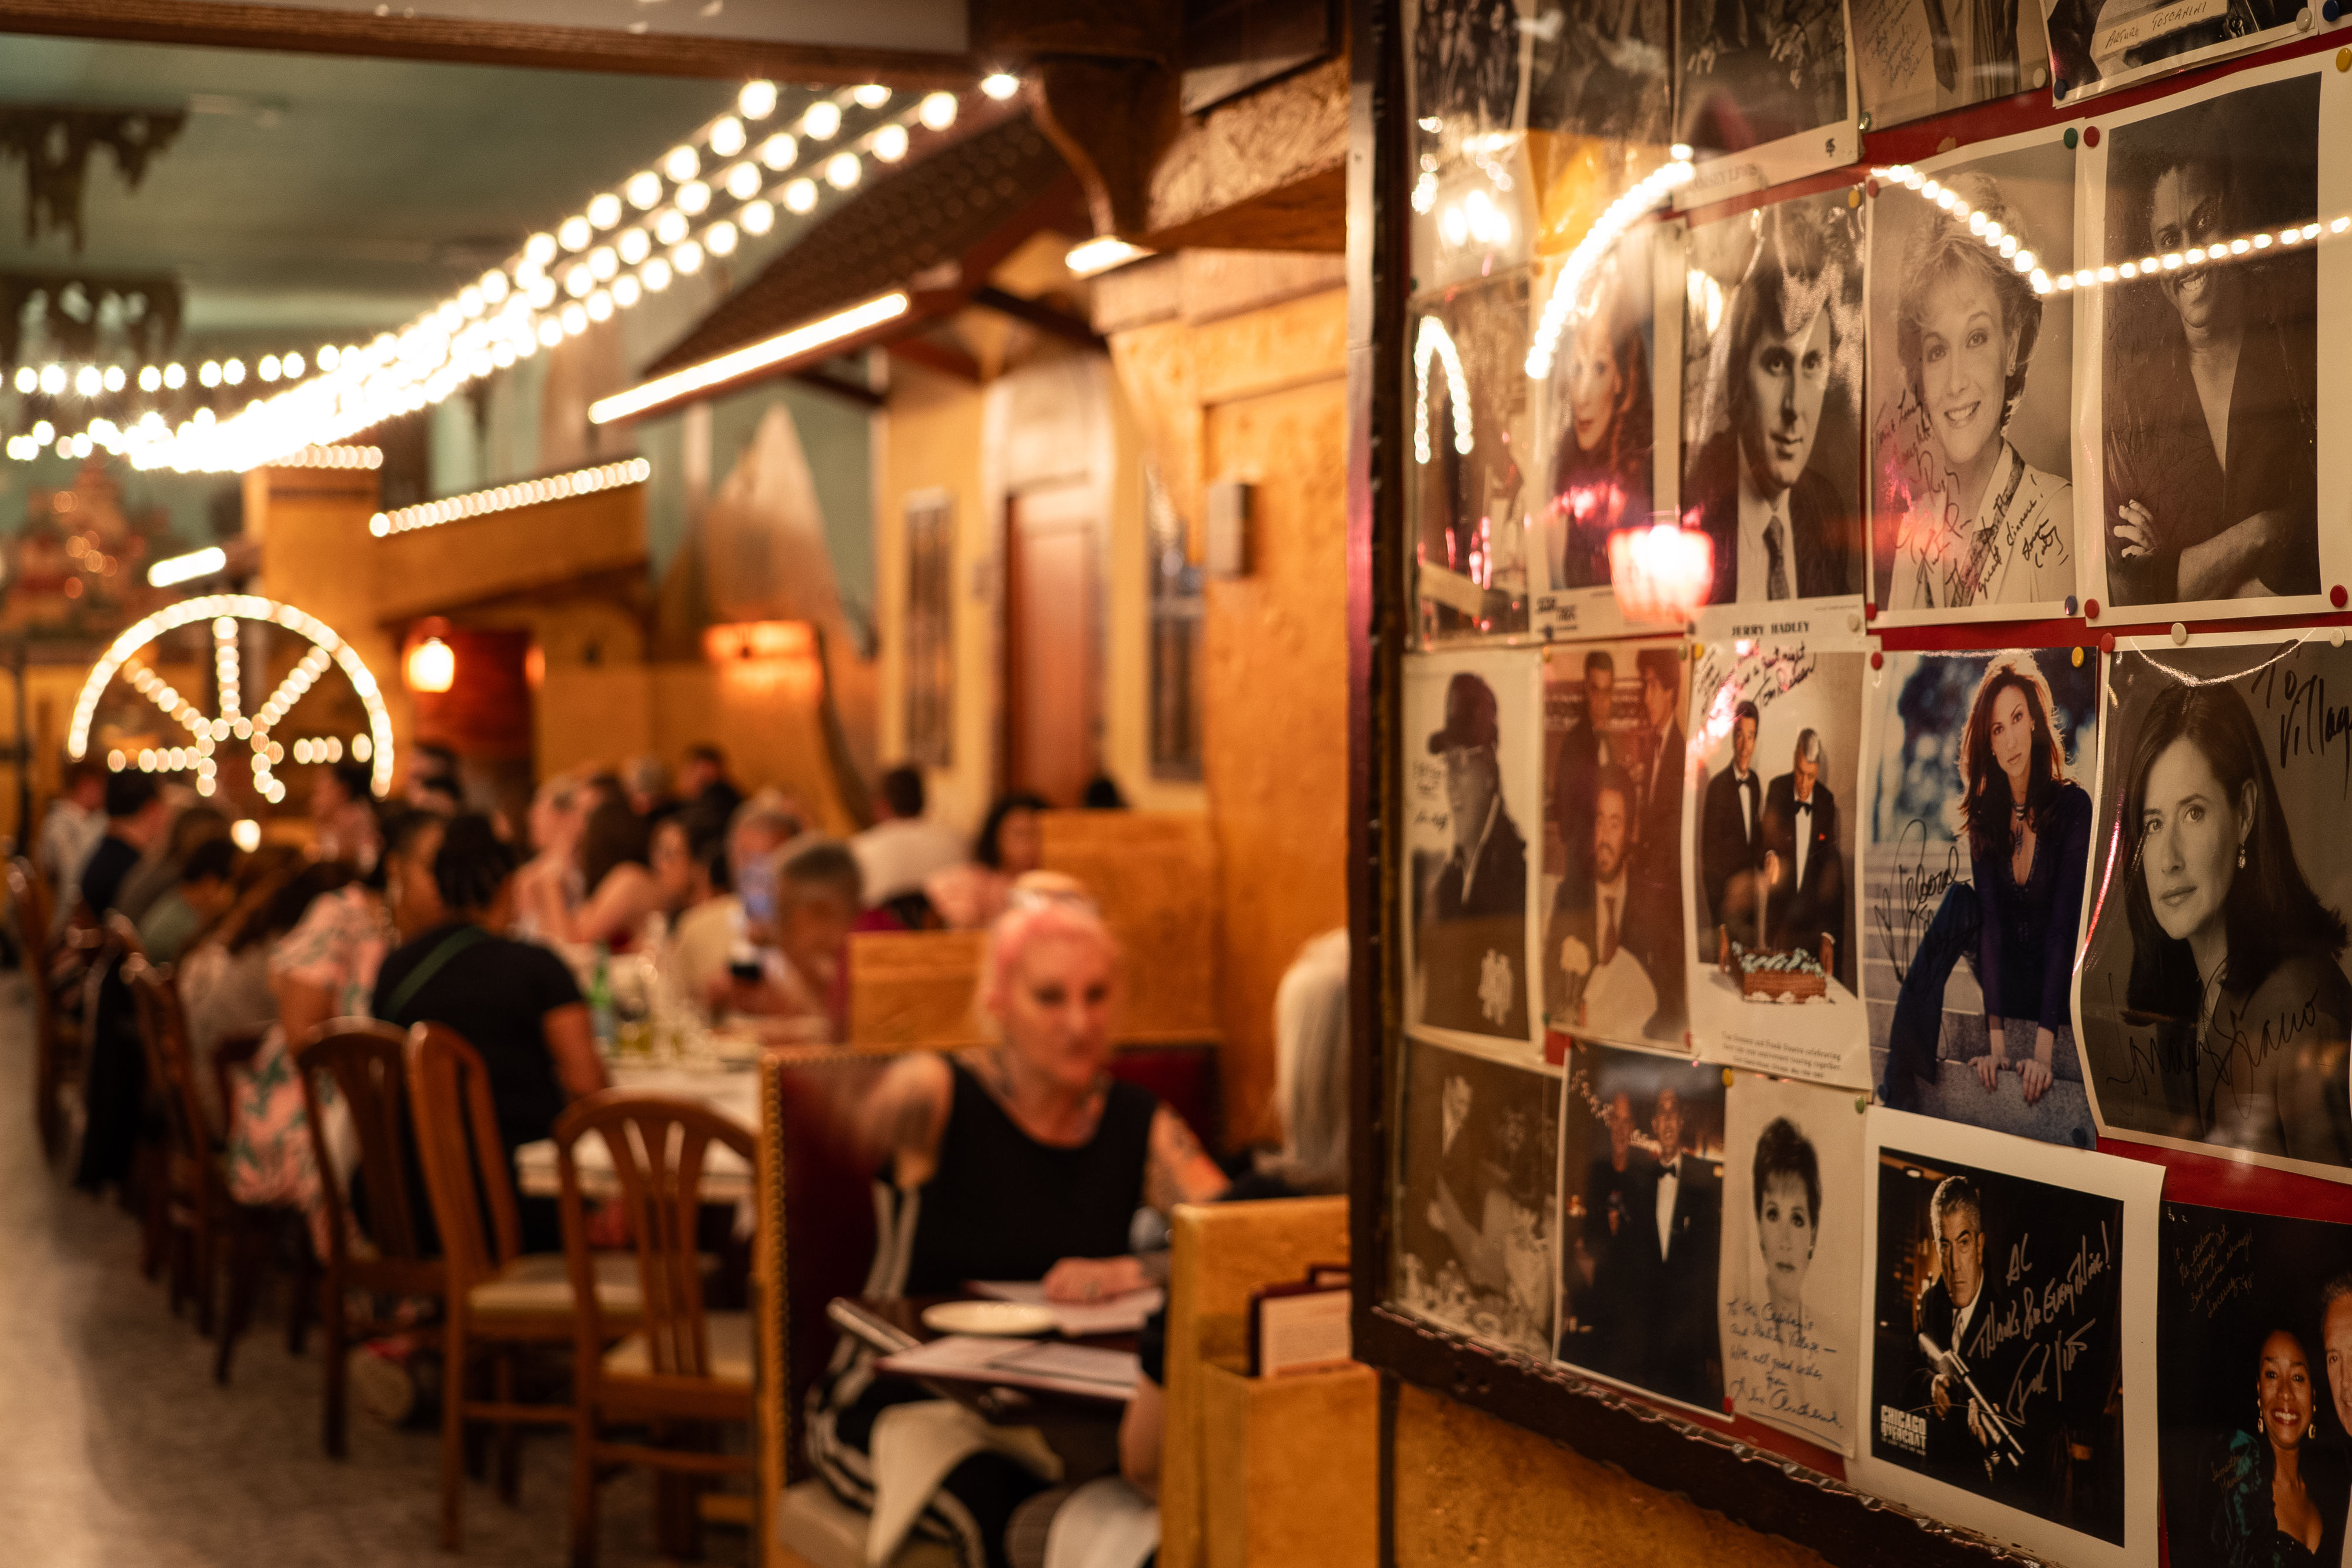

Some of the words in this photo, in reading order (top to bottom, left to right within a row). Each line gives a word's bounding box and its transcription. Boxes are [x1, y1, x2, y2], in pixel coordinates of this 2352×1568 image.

[2152, 2, 2207, 31] TOSCANINI
[1732, 624, 1764, 637] JERRY
[1770, 621, 1810, 634] HADLEY
[2251, 638, 2301, 709] To
[2280, 674, 2352, 801] Villag
[1880, 1404, 1926, 1436] CHICAGO
[1880, 1422, 1927, 1450] OVERCOAT
